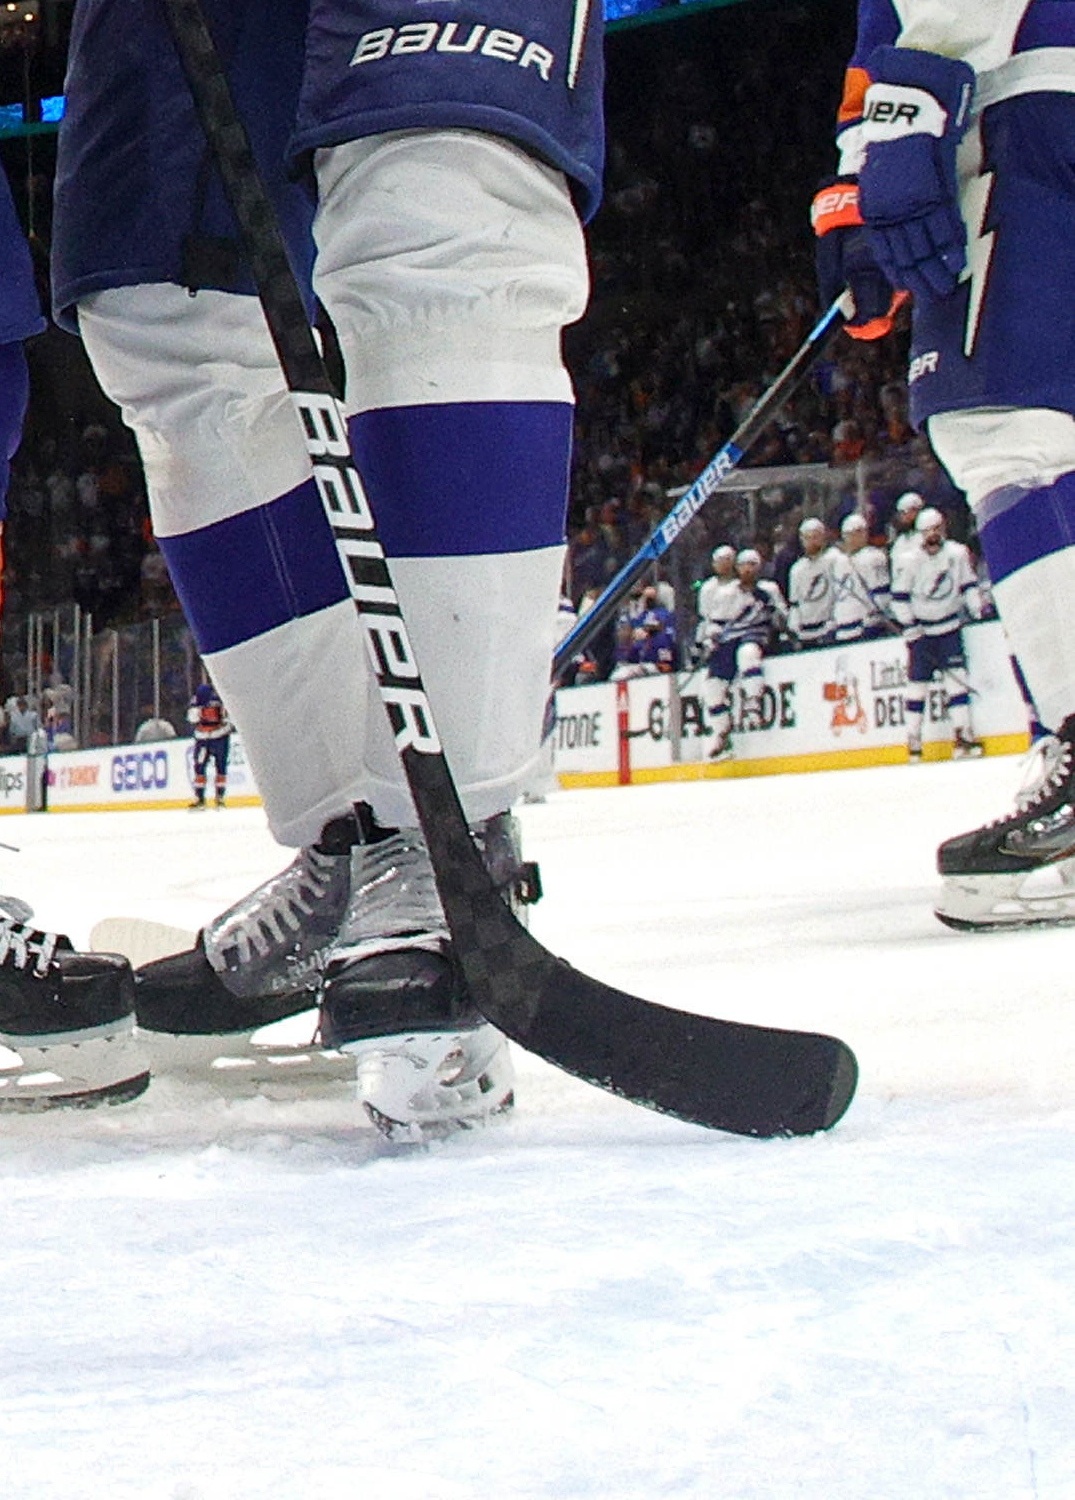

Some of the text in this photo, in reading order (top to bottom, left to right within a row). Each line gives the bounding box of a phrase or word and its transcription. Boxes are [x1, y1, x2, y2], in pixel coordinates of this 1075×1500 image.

[349, 21, 555, 81] BAUER
[662, 449, 735, 544] BAUER
[290, 393, 443, 755] BAUER
